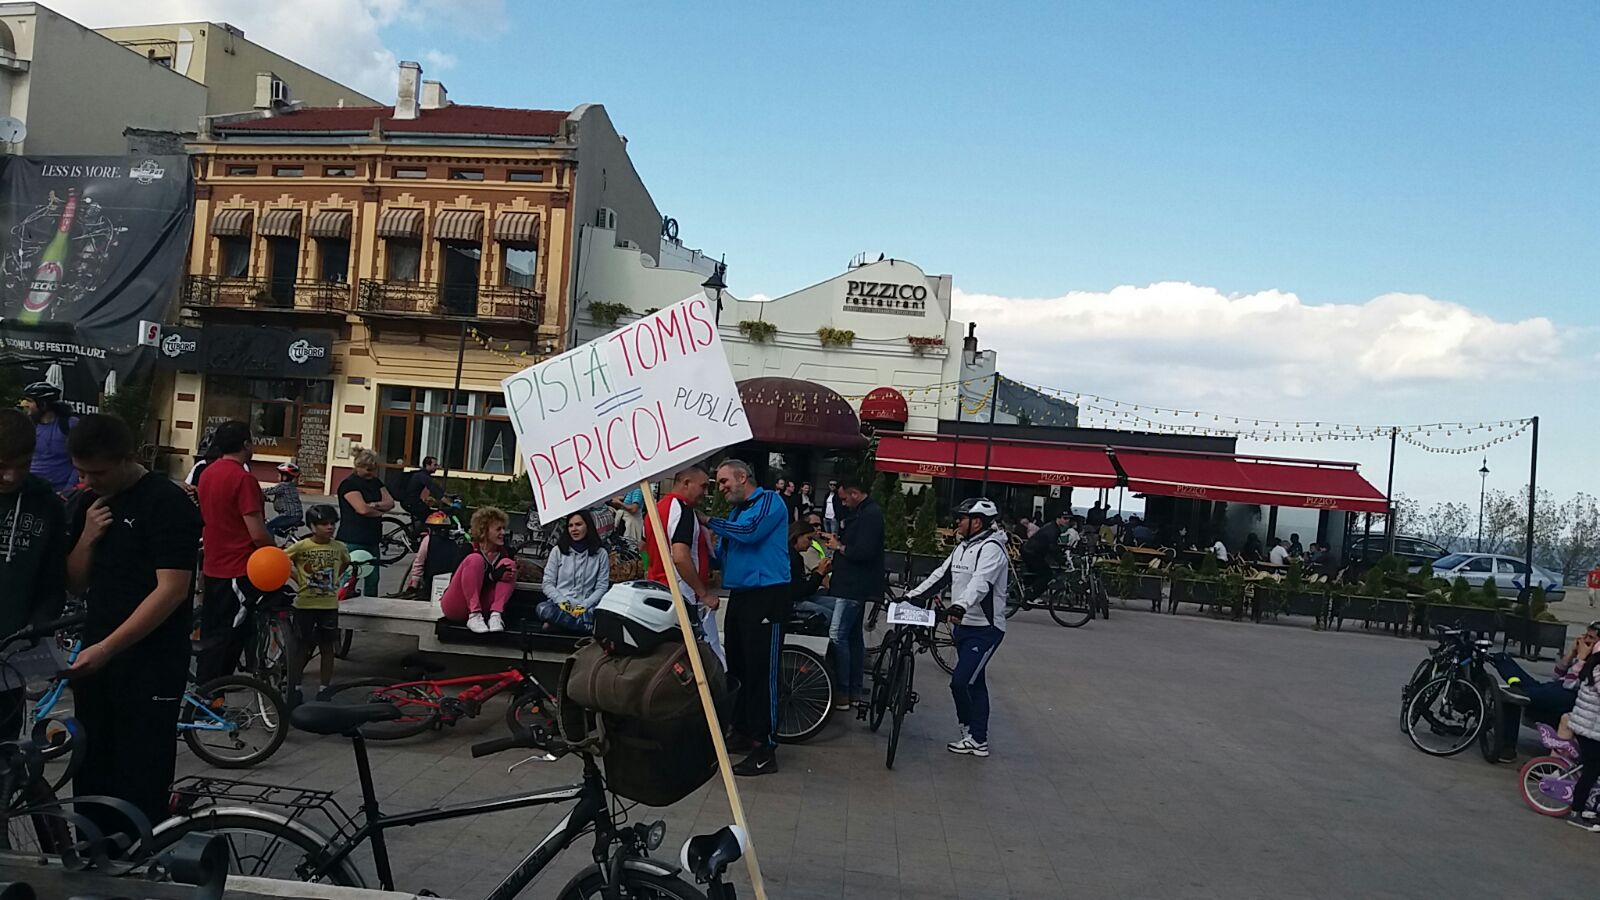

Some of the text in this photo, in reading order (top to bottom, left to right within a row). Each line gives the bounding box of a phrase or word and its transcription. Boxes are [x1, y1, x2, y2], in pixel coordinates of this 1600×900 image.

[42, 164, 68, 177] LESS
[70, 165, 82, 178] IS
[846, 280, 927, 301] PIZZICO
[845, 296, 925, 310] restaurant
[608, 299, 714, 377] TOMIS
[34, 341, 45, 352] DE
[46, 341, 107, 359] FESTIVALURI
[165, 341, 196, 352] TUBORG
[294, 347, 325, 358] TUBORG
[530, 386, 744, 511] PERICOL PUBLIC
[919, 463, 947, 473] PIZZICO
[1040, 473, 1070, 482] PIZZICO
[1176, 485, 1206, 495] PIZZICO
[1306, 496, 1337, 506] PIZZICO
